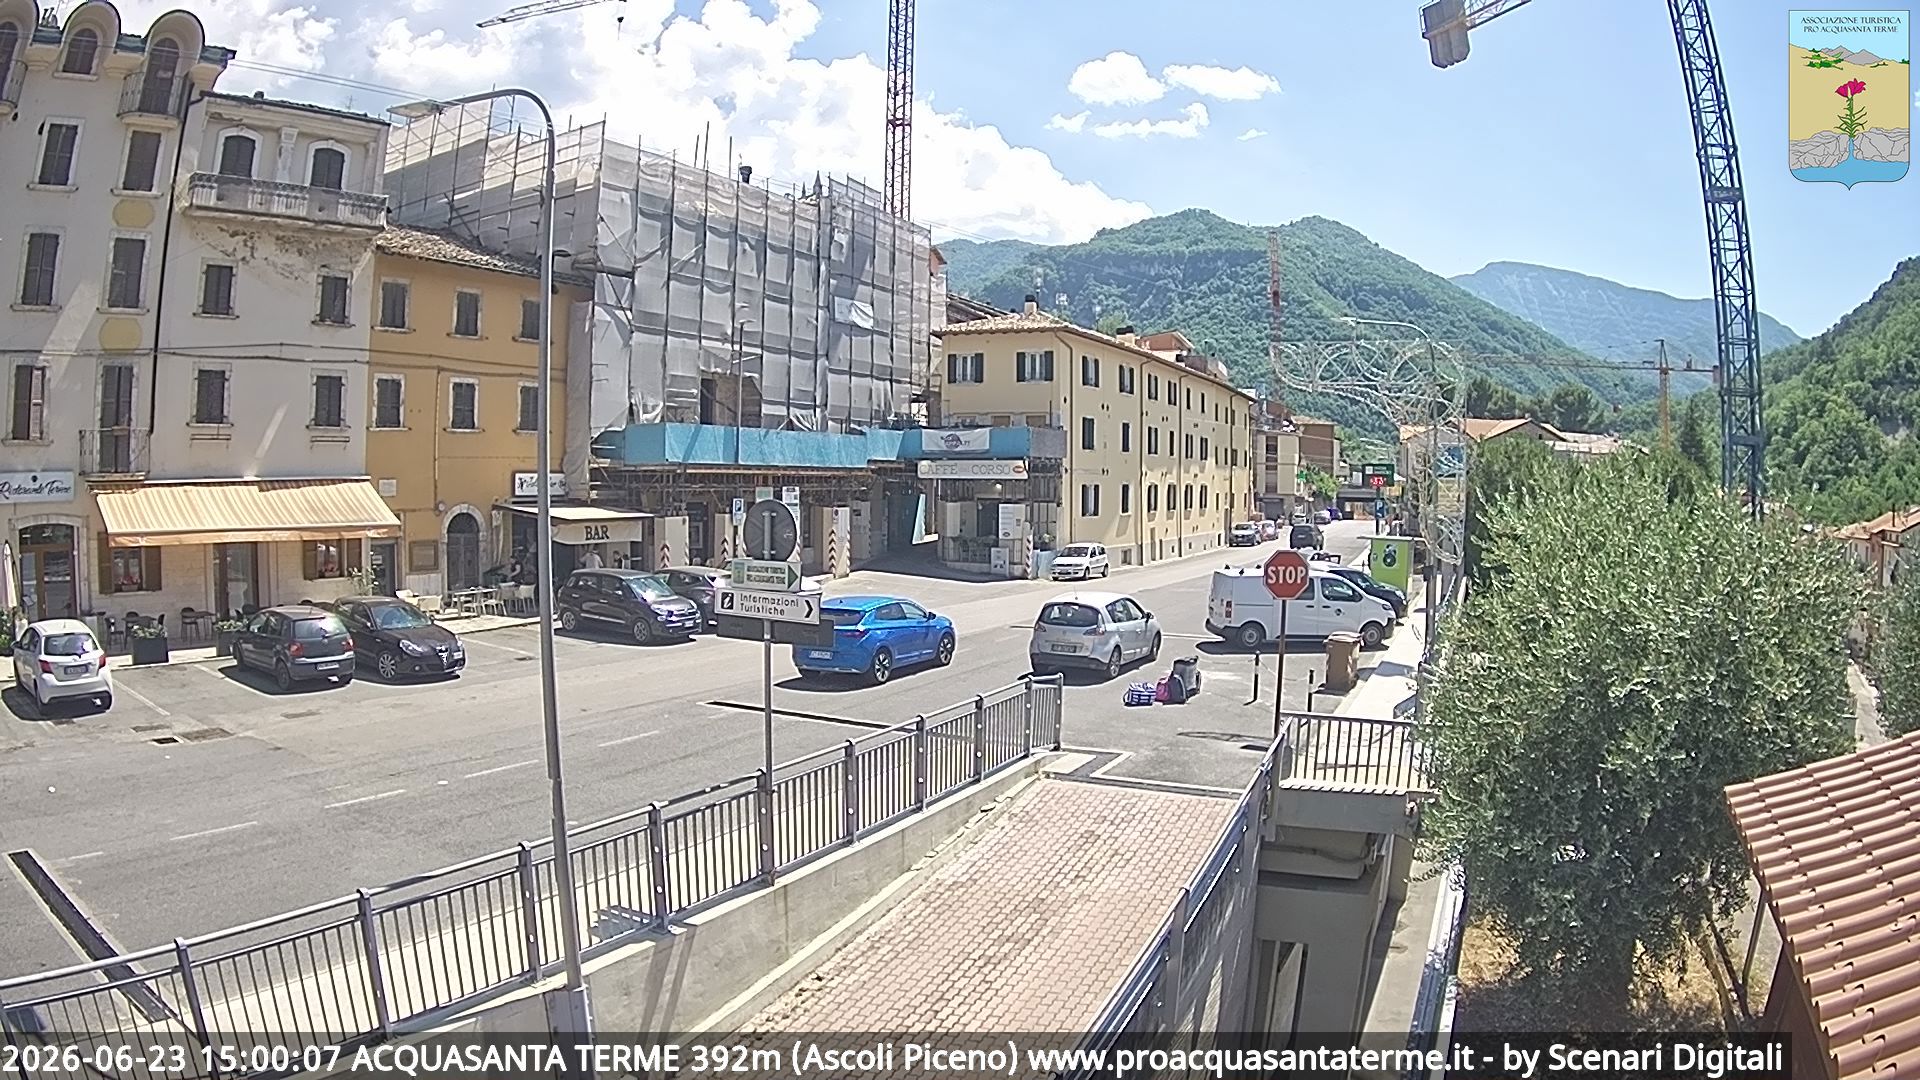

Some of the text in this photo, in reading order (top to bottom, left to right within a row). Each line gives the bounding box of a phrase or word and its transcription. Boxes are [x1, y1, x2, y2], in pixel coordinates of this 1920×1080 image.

[971, 464, 1011, 475] CORSO
[584, 525, 610, 541] BAR
[1267, 565, 1306, 585] STOP
[740, 593, 799, 608] Informazioni
[740, 603, 785, 617] Turistiche
